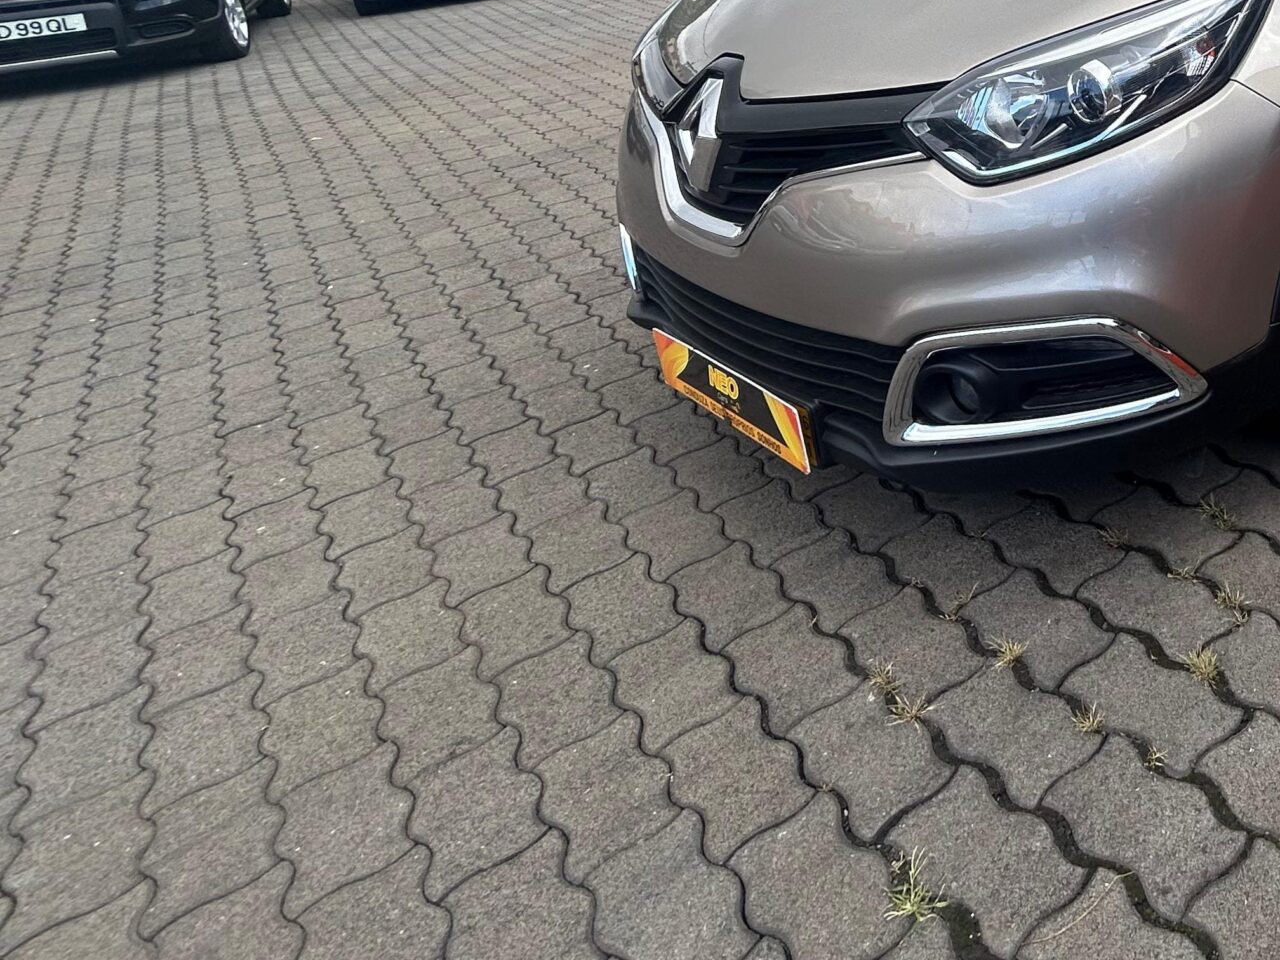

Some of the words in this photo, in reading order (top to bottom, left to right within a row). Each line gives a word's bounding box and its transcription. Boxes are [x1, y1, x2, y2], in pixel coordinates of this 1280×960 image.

[15, 22, 43, 37] 99
[46, 17, 77, 33] QL
[708, 364, 739, 400] NEO
